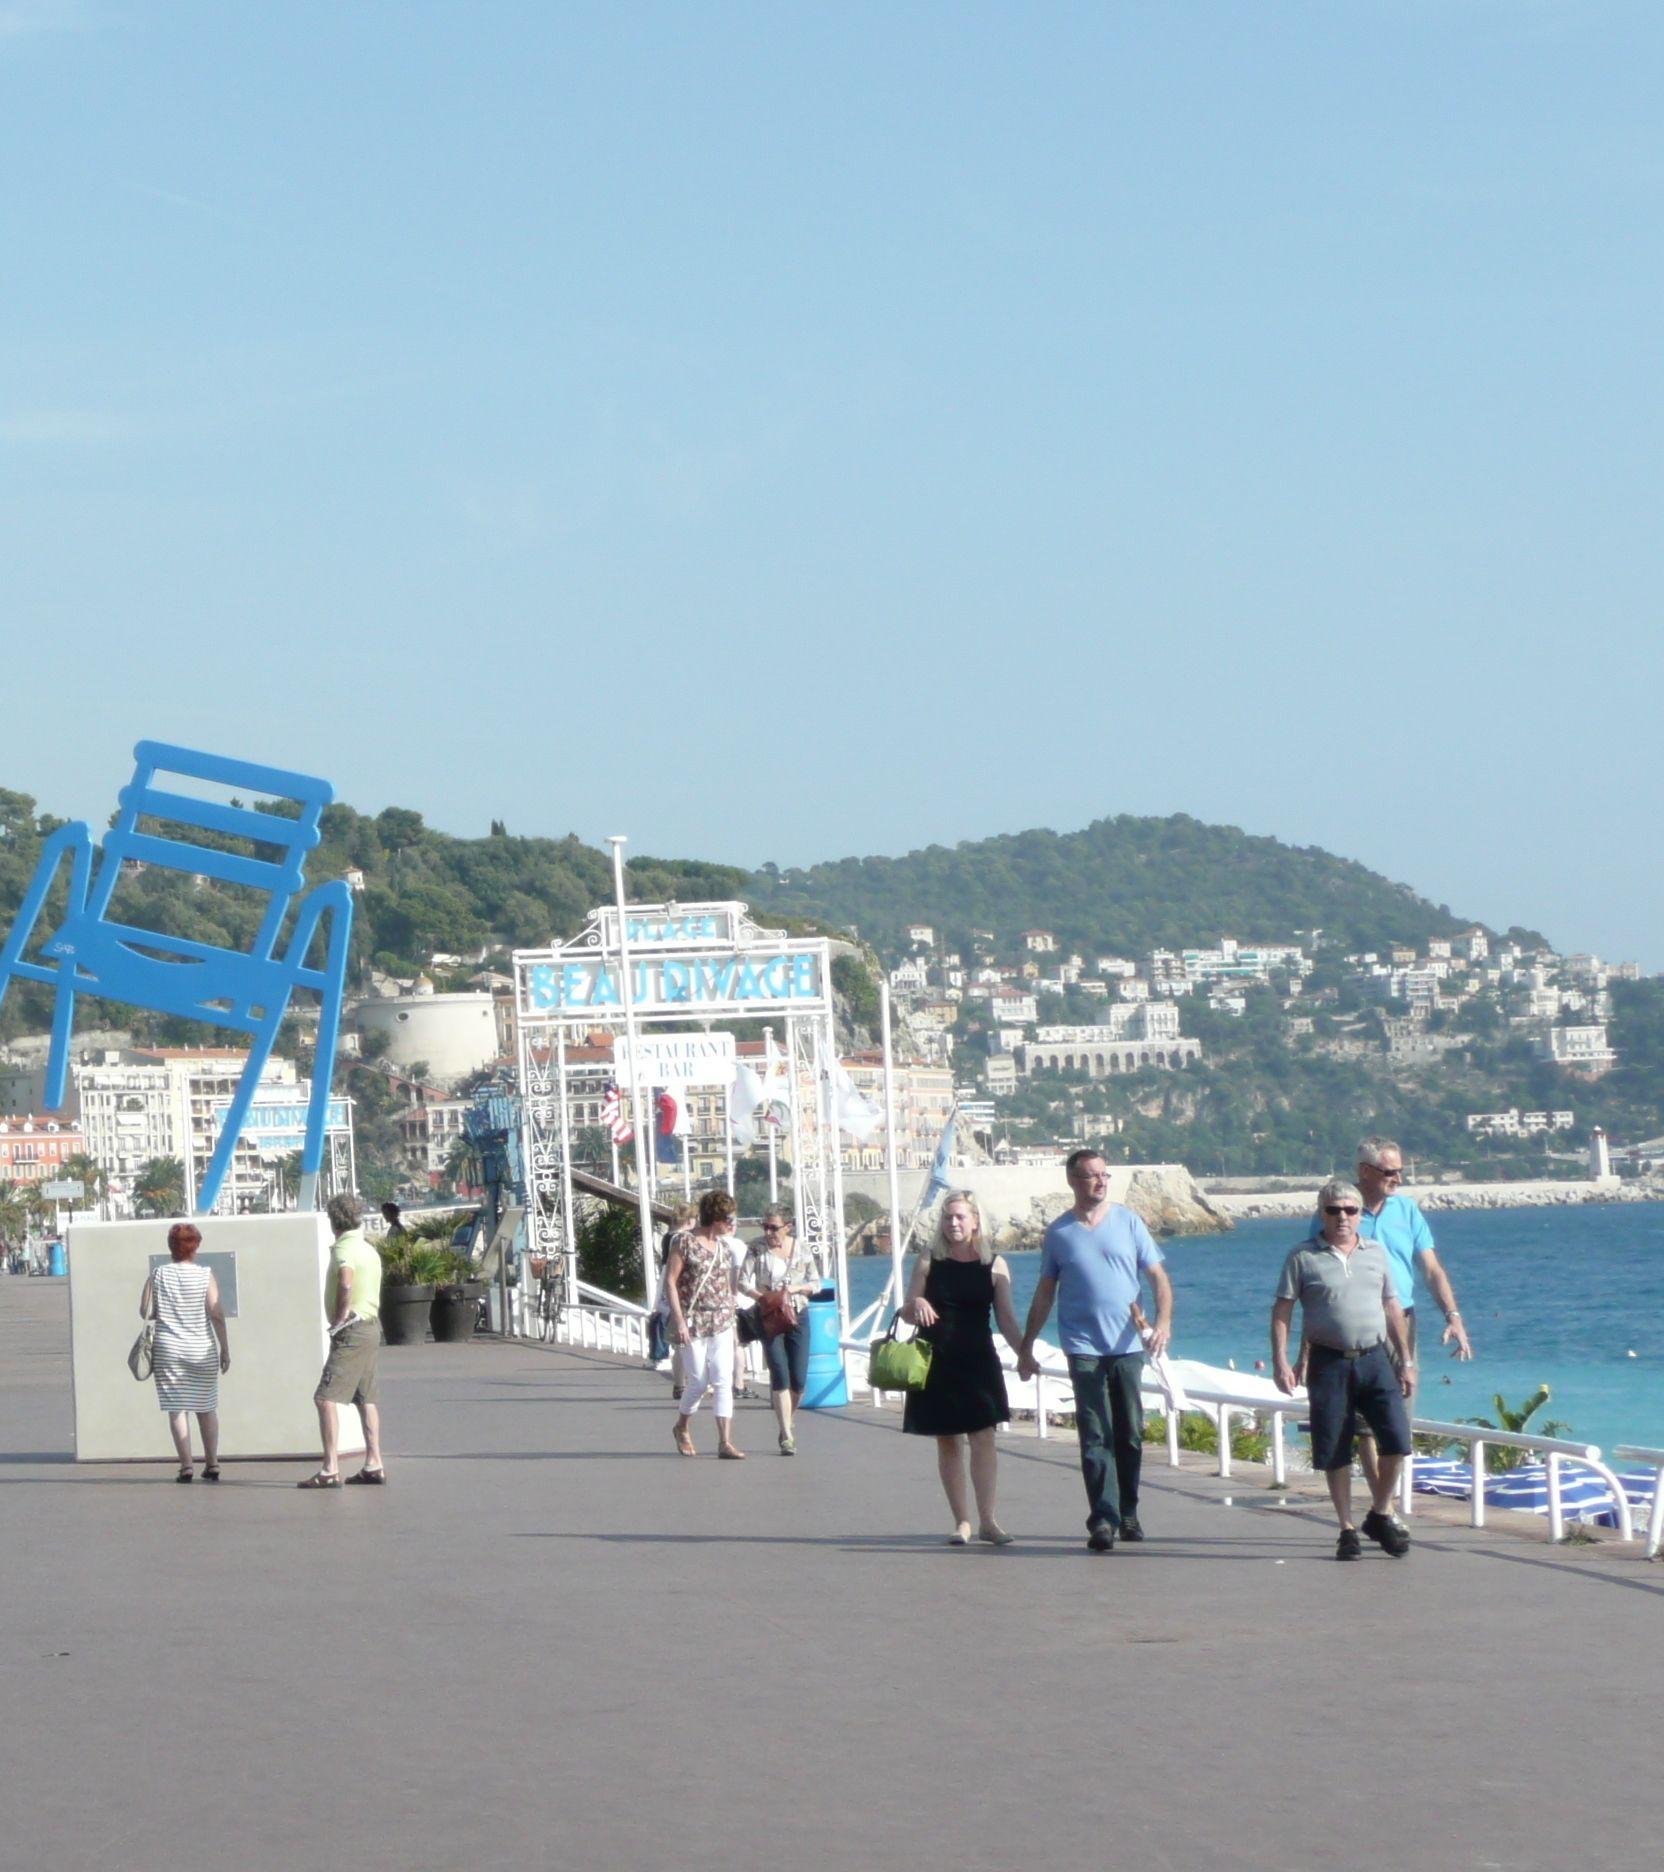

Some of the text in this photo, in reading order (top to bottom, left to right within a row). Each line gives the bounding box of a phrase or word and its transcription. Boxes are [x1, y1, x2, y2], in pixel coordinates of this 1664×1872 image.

[625, 915, 716, 941] PLAGE
[531, 953, 817, 1009] BEAU RIVAGE
[660, 1062, 694, 1078] BAR
